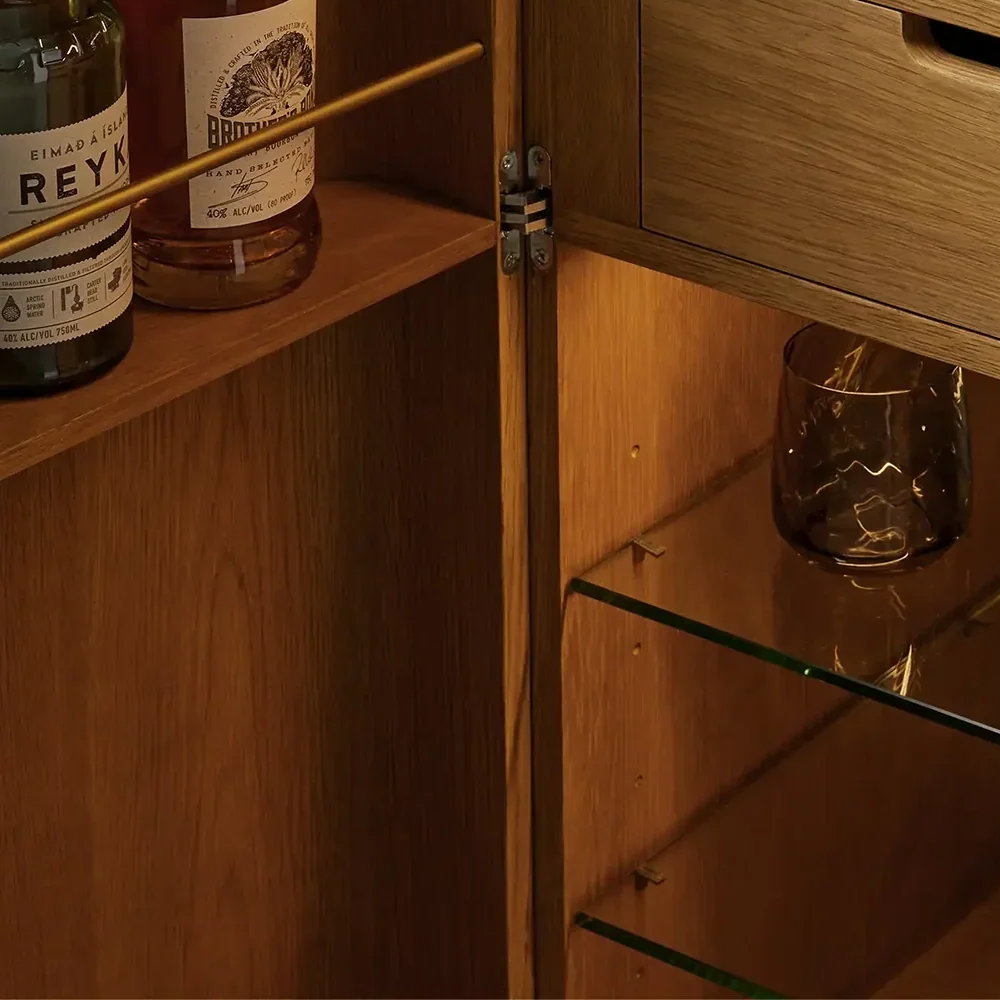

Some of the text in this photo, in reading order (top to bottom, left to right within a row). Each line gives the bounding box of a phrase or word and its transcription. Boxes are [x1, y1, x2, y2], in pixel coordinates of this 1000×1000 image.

[210, 75, 226, 109] DISTILLED
[228, 45, 252, 68] CRAFTED
[253, 38, 262, 47] IN
[263, 30, 274, 40] THE
[90, 131, 98, 145] Á
[205, 168, 243, 178] HAND
[249, 147, 301, 173] SELECTED
[206, 207, 228, 219] 40%
[233, 203, 264, 217] ALC/VOL
[267, 198, 279, 209] (80
[279, 188, 298, 204] PROOF)
[2, 279, 46, 287] TRADITIONALLY
[48, 272, 76, 283] DISTILLED
[82, 260, 103, 274] FILTERED
[26, 295, 44, 303] ARCTIC
[26, 303, 45, 311] SPRING
[87, 296, 99, 305] STILL
[4, 323, 80, 343] 40% ALC/VOL 750ML
